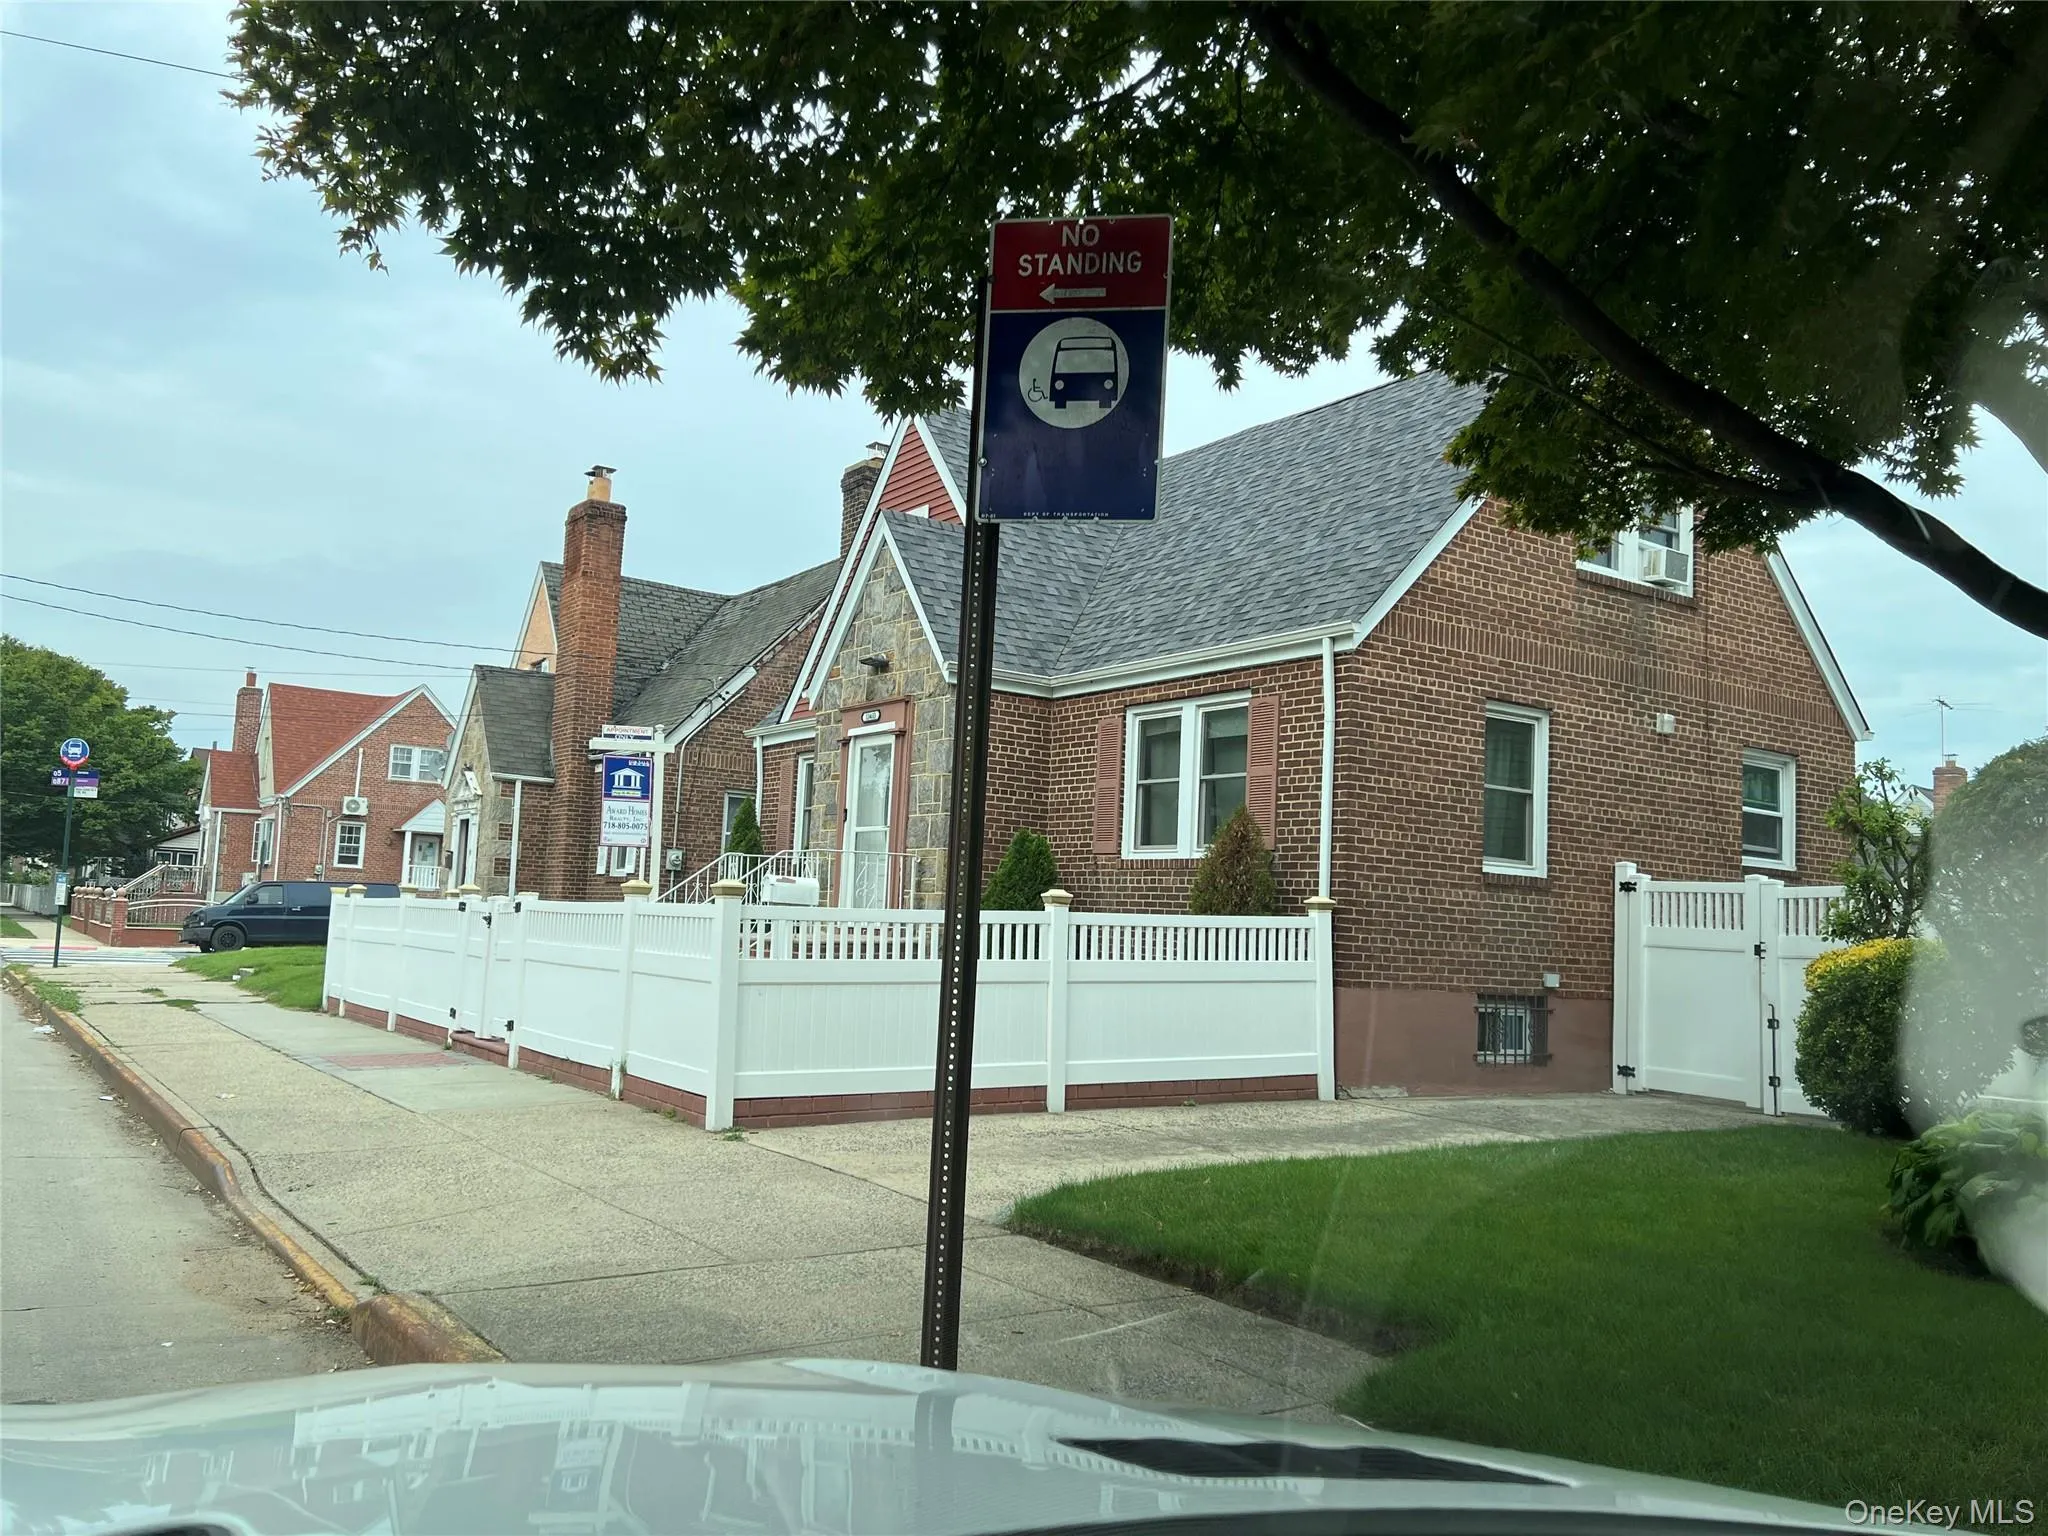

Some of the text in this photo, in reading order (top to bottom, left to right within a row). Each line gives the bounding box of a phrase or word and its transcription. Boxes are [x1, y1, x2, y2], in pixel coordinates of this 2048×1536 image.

[1062, 224, 1100, 247] NO
[1018, 250, 1142, 277] STANDING
[607, 727, 649, 735] APPOINTMENT
[603, 821, 648, 831] 718-805-0075
